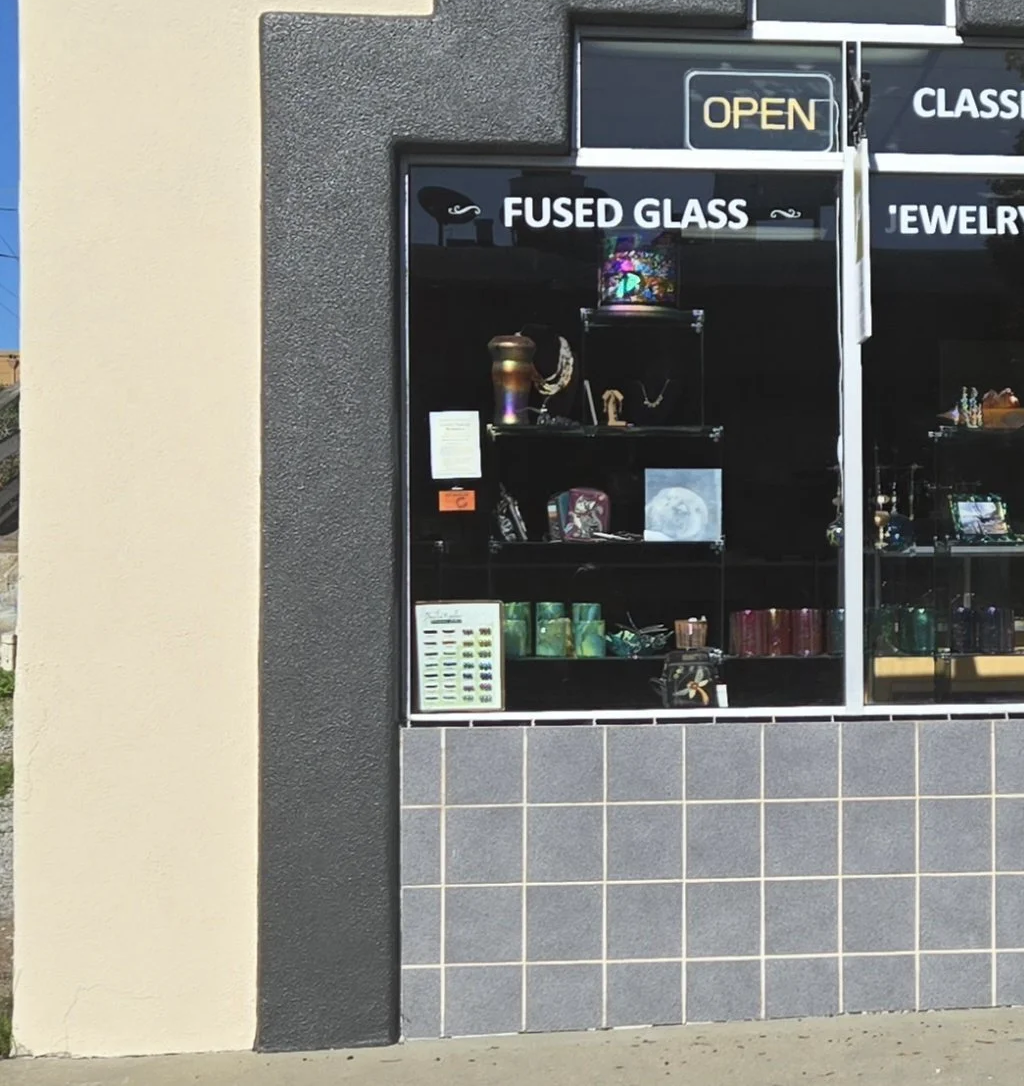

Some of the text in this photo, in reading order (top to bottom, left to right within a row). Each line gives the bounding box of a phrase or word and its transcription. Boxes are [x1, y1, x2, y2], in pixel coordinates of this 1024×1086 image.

[703, 96, 816, 131] OPEN
[503, 196, 749, 231] FUSED GLASS
